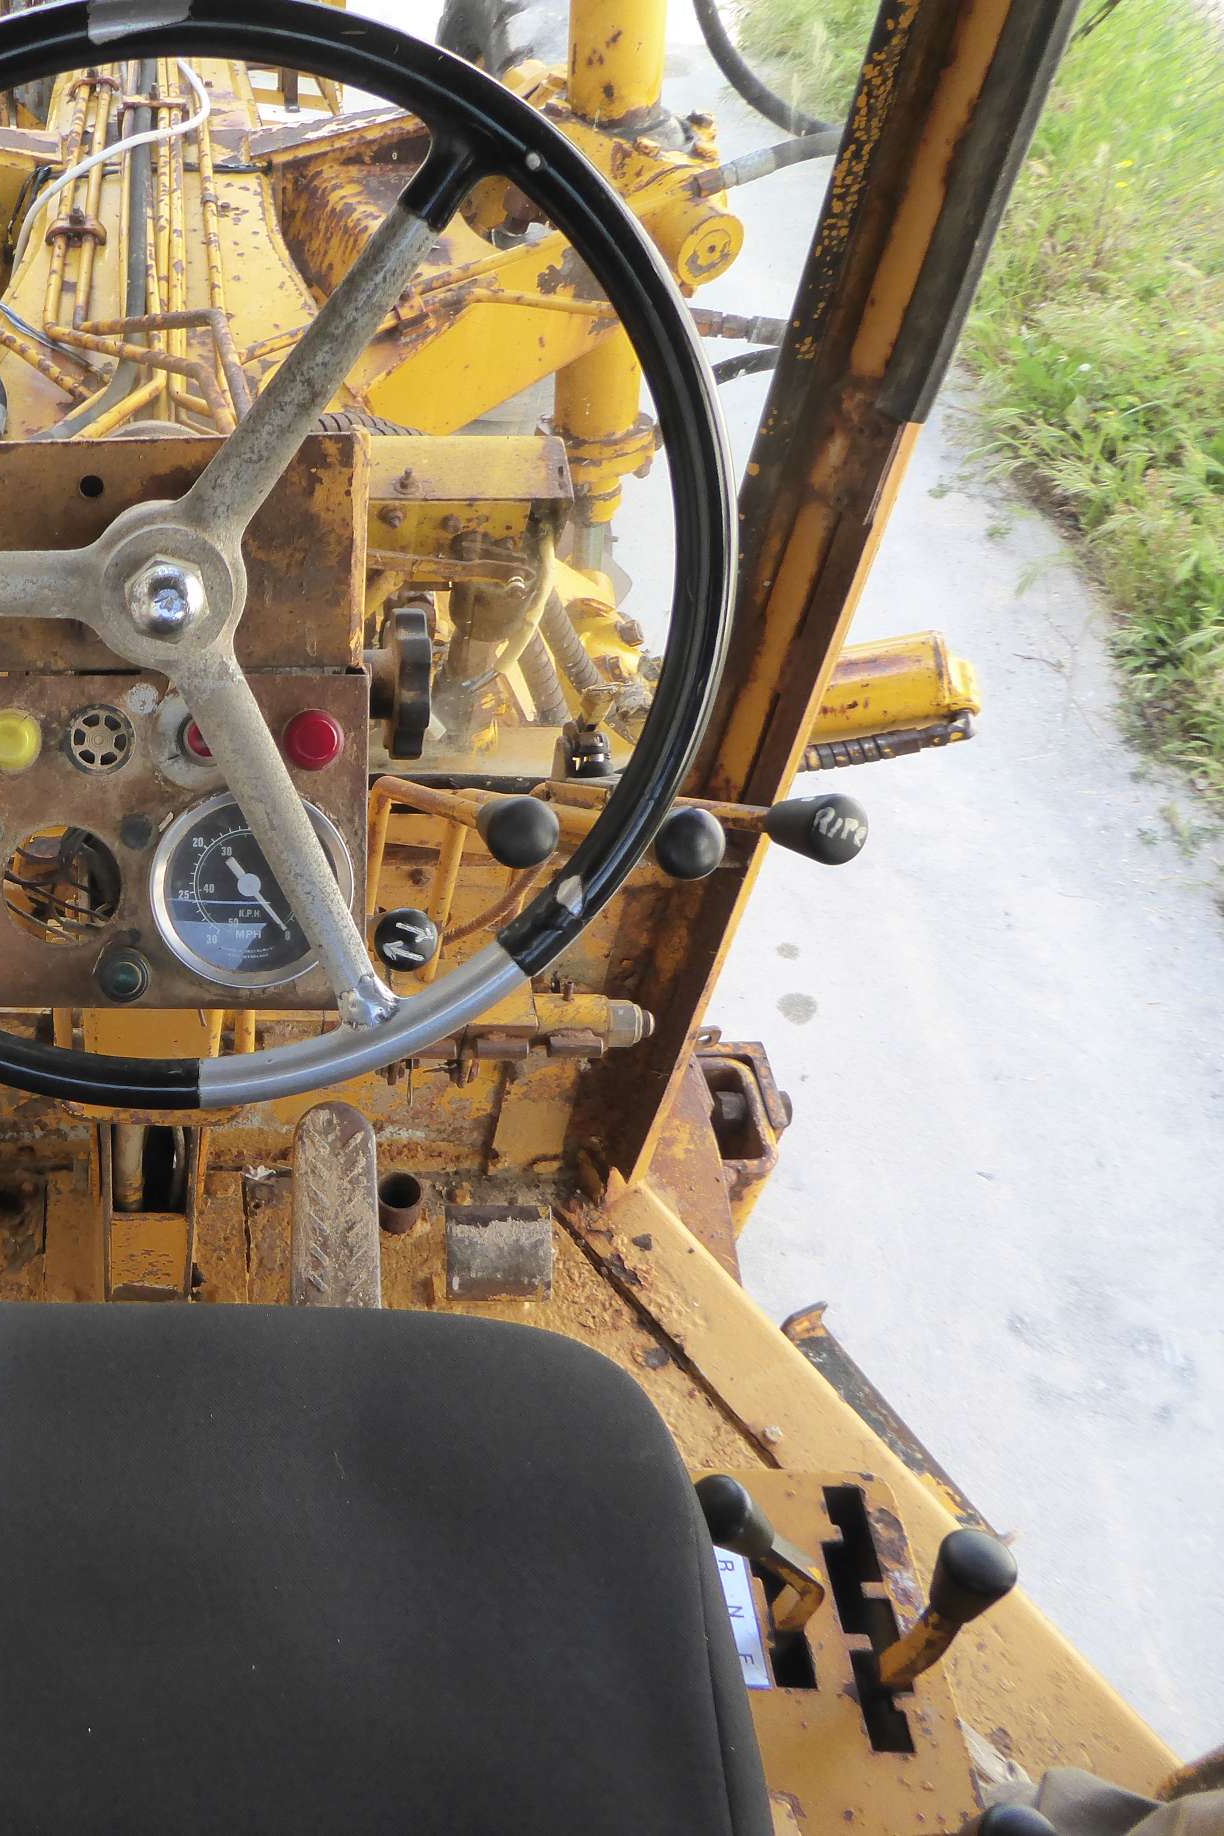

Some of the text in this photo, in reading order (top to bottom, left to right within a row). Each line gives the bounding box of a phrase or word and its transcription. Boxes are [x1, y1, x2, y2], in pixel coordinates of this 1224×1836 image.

[192, 837, 204, 848] 20
[221, 846, 232, 857] 30
[203, 883, 215, 894] 40
[178, 890, 190, 900] 25
[206, 934, 217, 944] 30
[235, 929, 262, 940] MPH
[718, 1559, 734, 1572] R
[727, 1604, 745, 1619] N
